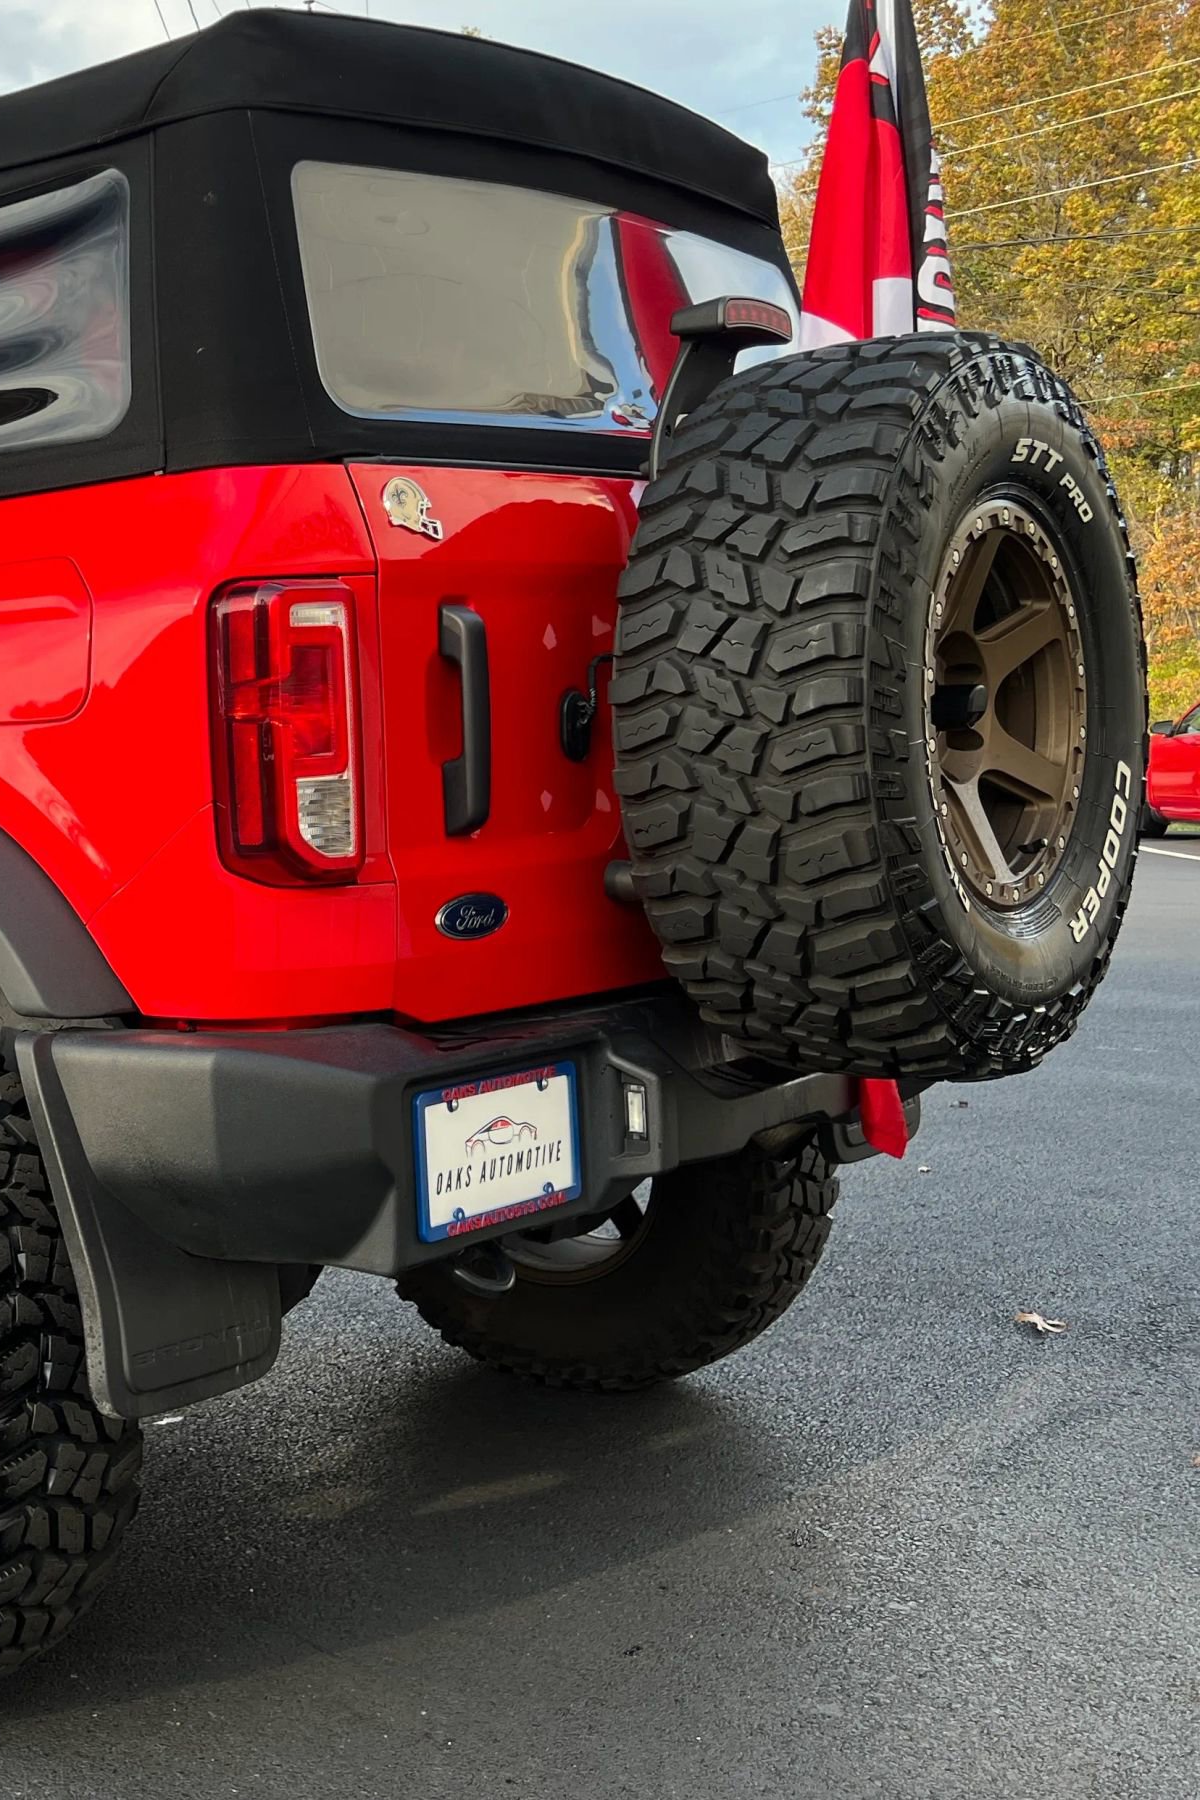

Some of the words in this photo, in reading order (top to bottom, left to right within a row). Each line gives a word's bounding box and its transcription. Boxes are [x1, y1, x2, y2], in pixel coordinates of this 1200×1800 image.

[1010, 438, 1064, 473] STT
[1059, 472, 1094, 523] PRO
[1068, 760, 1131, 943] COOPER
[456, 904, 495, 930] Ford
[442, 1084, 476, 1101] OAKS
[478, 1066, 557, 1095] AUTOMOTIVE
[436, 1165, 472, 1195] OAKS
[480, 1140, 562, 1184] AUTOMOTIVE
